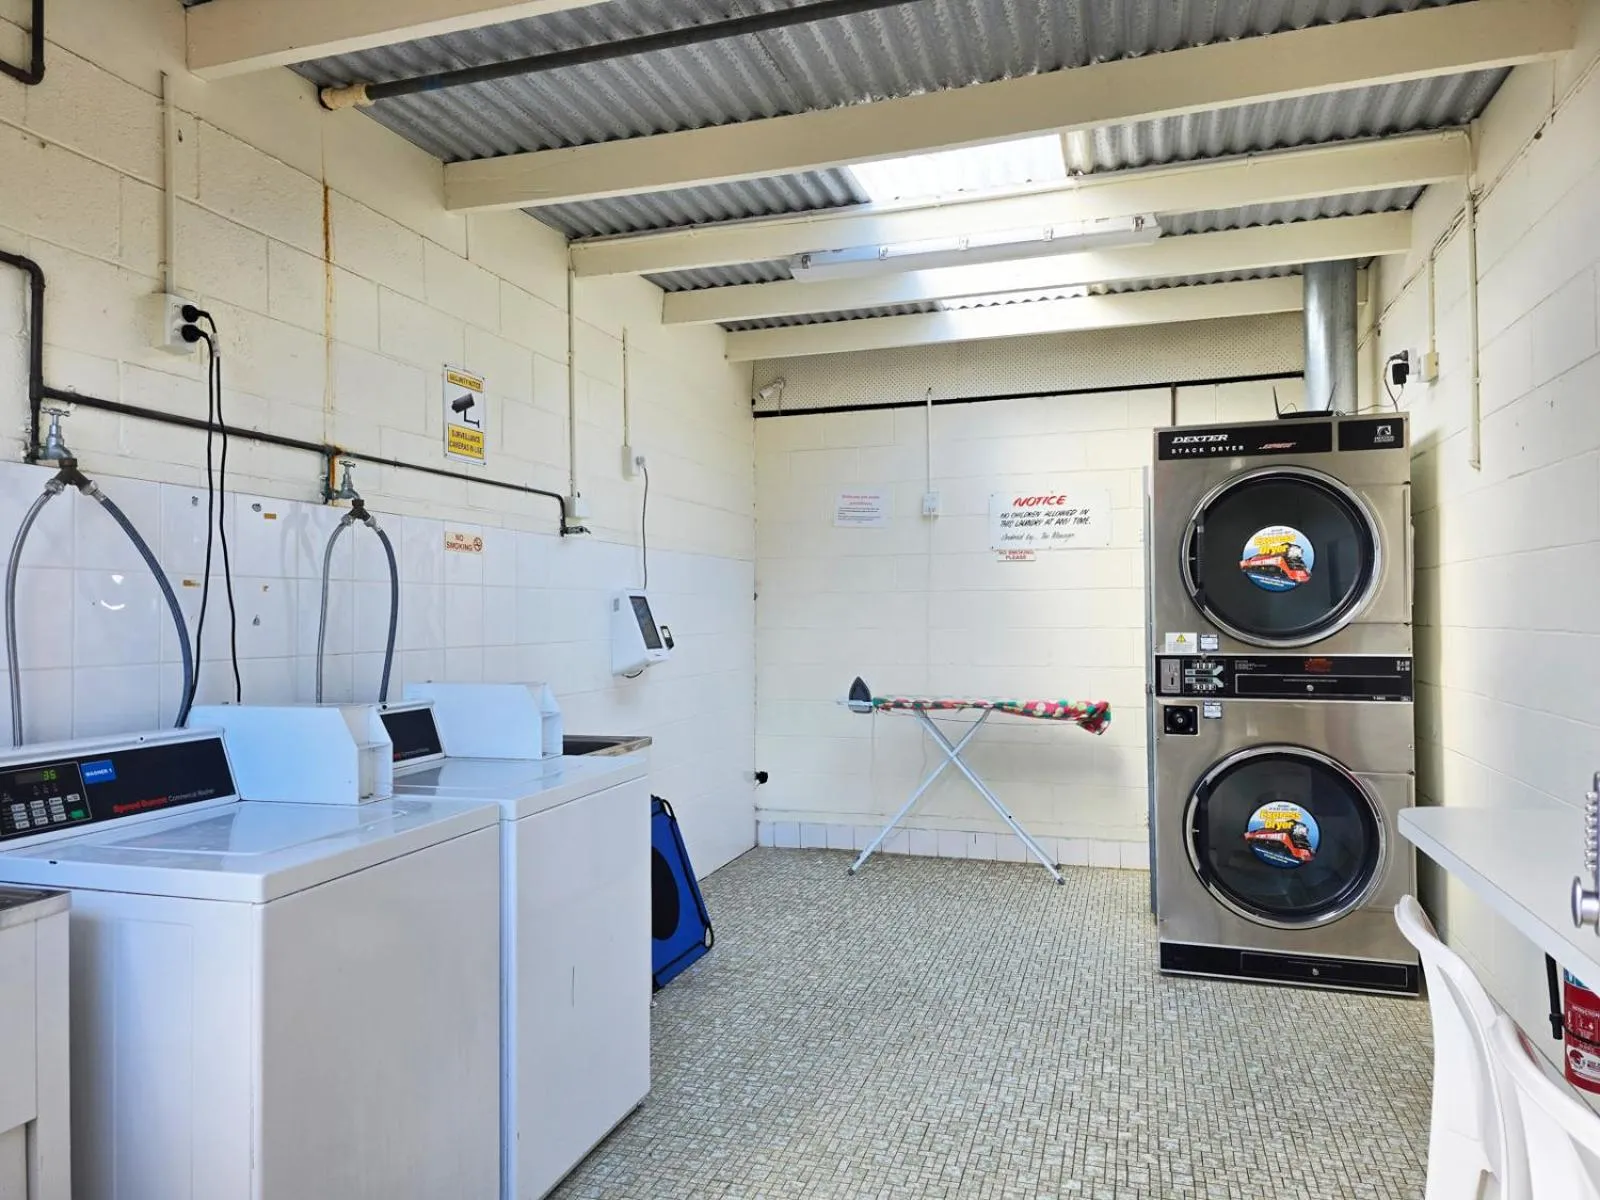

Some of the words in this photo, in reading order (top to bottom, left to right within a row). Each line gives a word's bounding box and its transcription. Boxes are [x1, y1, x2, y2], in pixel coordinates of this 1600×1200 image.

[1172, 434, 1228, 445] DEXTER
[1171, 447, 1205, 455] STACK
[1211, 445, 1245, 453] DRYER
[1013, 495, 1068, 507] NOTICE
[1001, 511, 1010, 519] NO
[1011, 511, 1041, 519] CHILDREN
[1044, 509, 1077, 517] ALLOWED
[1080, 508, 1090, 516] IN
[1000, 520, 1013, 528] THIS
[1015, 519, 1042, 528] LAUNDRY
[1044, 518, 1054, 526] AT
[455, 534, 464, 542] NO
[447, 541, 473, 551] SMOKING
[1264, 820, 1294, 830] Dryer
